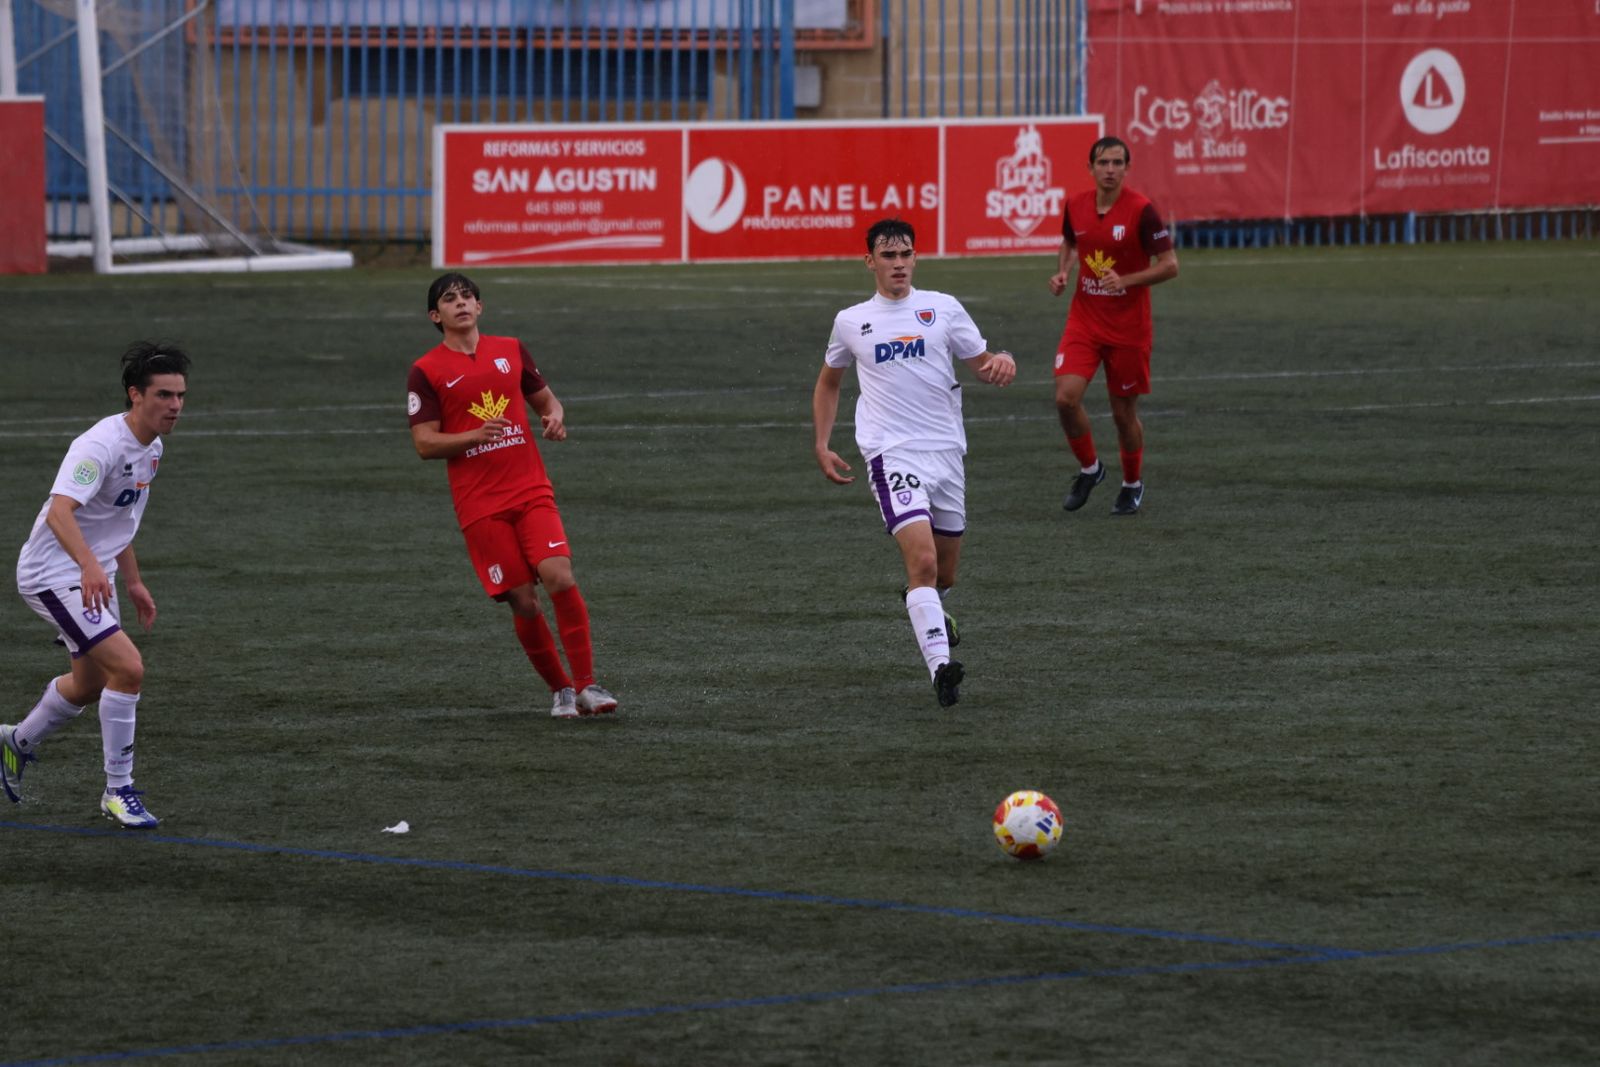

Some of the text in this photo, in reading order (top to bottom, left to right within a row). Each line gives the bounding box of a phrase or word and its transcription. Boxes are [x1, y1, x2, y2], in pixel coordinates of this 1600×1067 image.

[1127, 85, 1290, 144] Las Villas
[484, 139, 645, 157] REFORMAS Y SERVICIOS
[1173, 140, 1194, 159] del
[1373, 144, 1491, 171] Lafisconta
[472, 166, 657, 193] SAN AGUSTIN
[1001, 163, 1045, 191] LIFE
[763, 183, 939, 217] PANELAIS
[986, 187, 1065, 218] SPORT
[743, 215, 855, 230] PRODUCCIONES
[875, 338, 926, 364] DPM
[493, 424, 524, 439] URAL
[465, 437, 526, 458] DE SALAMANCA
[889, 472, 920, 492] 20
